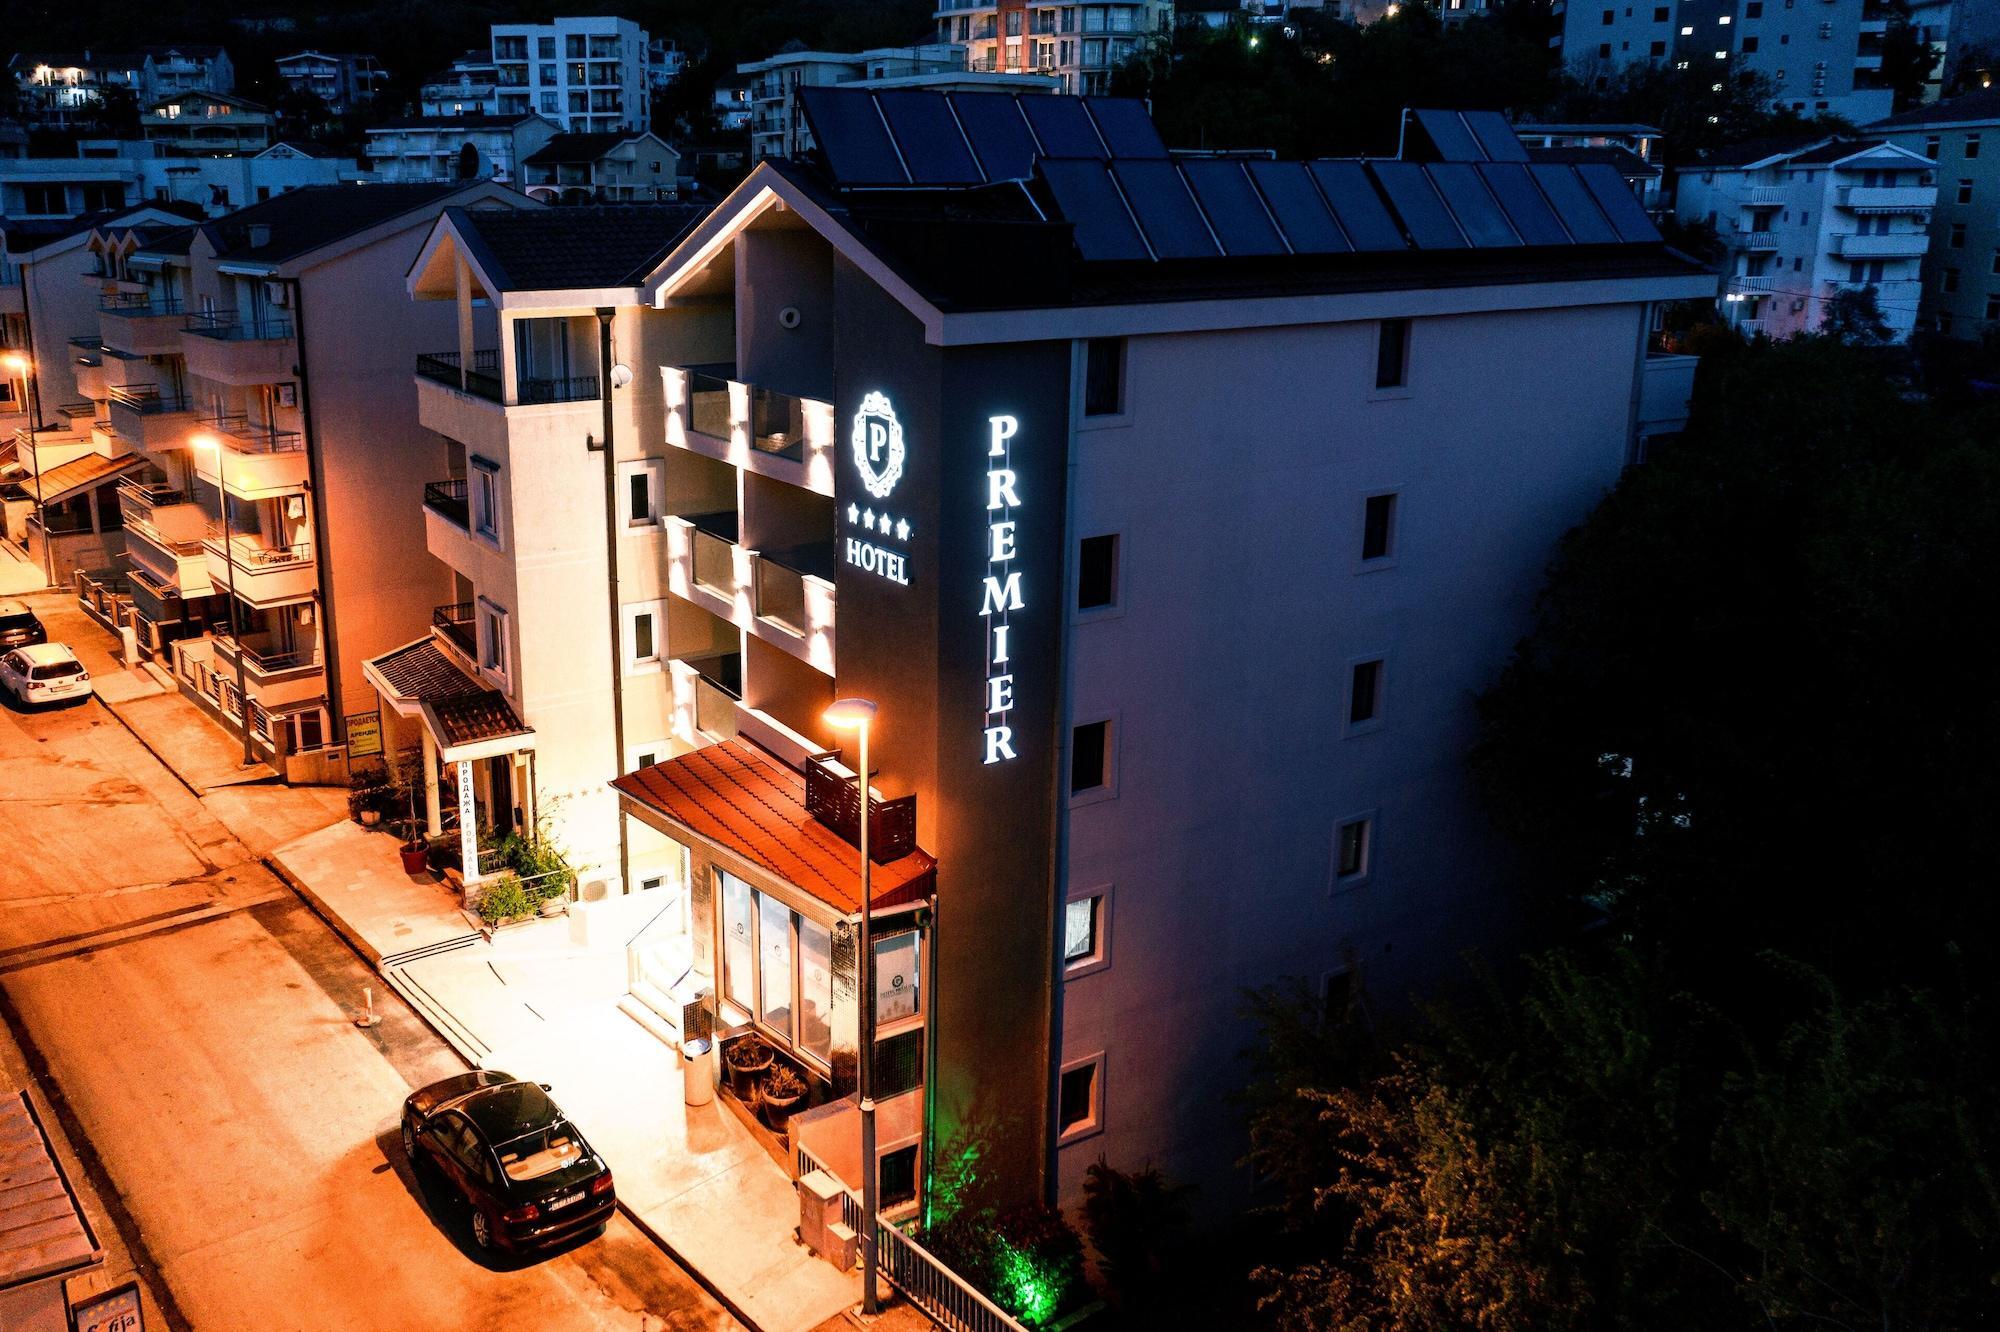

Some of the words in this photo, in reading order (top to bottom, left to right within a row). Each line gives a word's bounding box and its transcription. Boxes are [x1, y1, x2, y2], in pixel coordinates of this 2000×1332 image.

[869, 423, 887, 461] P
[847, 538, 909, 586] HOTEL
[979, 415, 1025, 765] PREMIER
[462, 761, 471, 814] ПРОДАЖА
